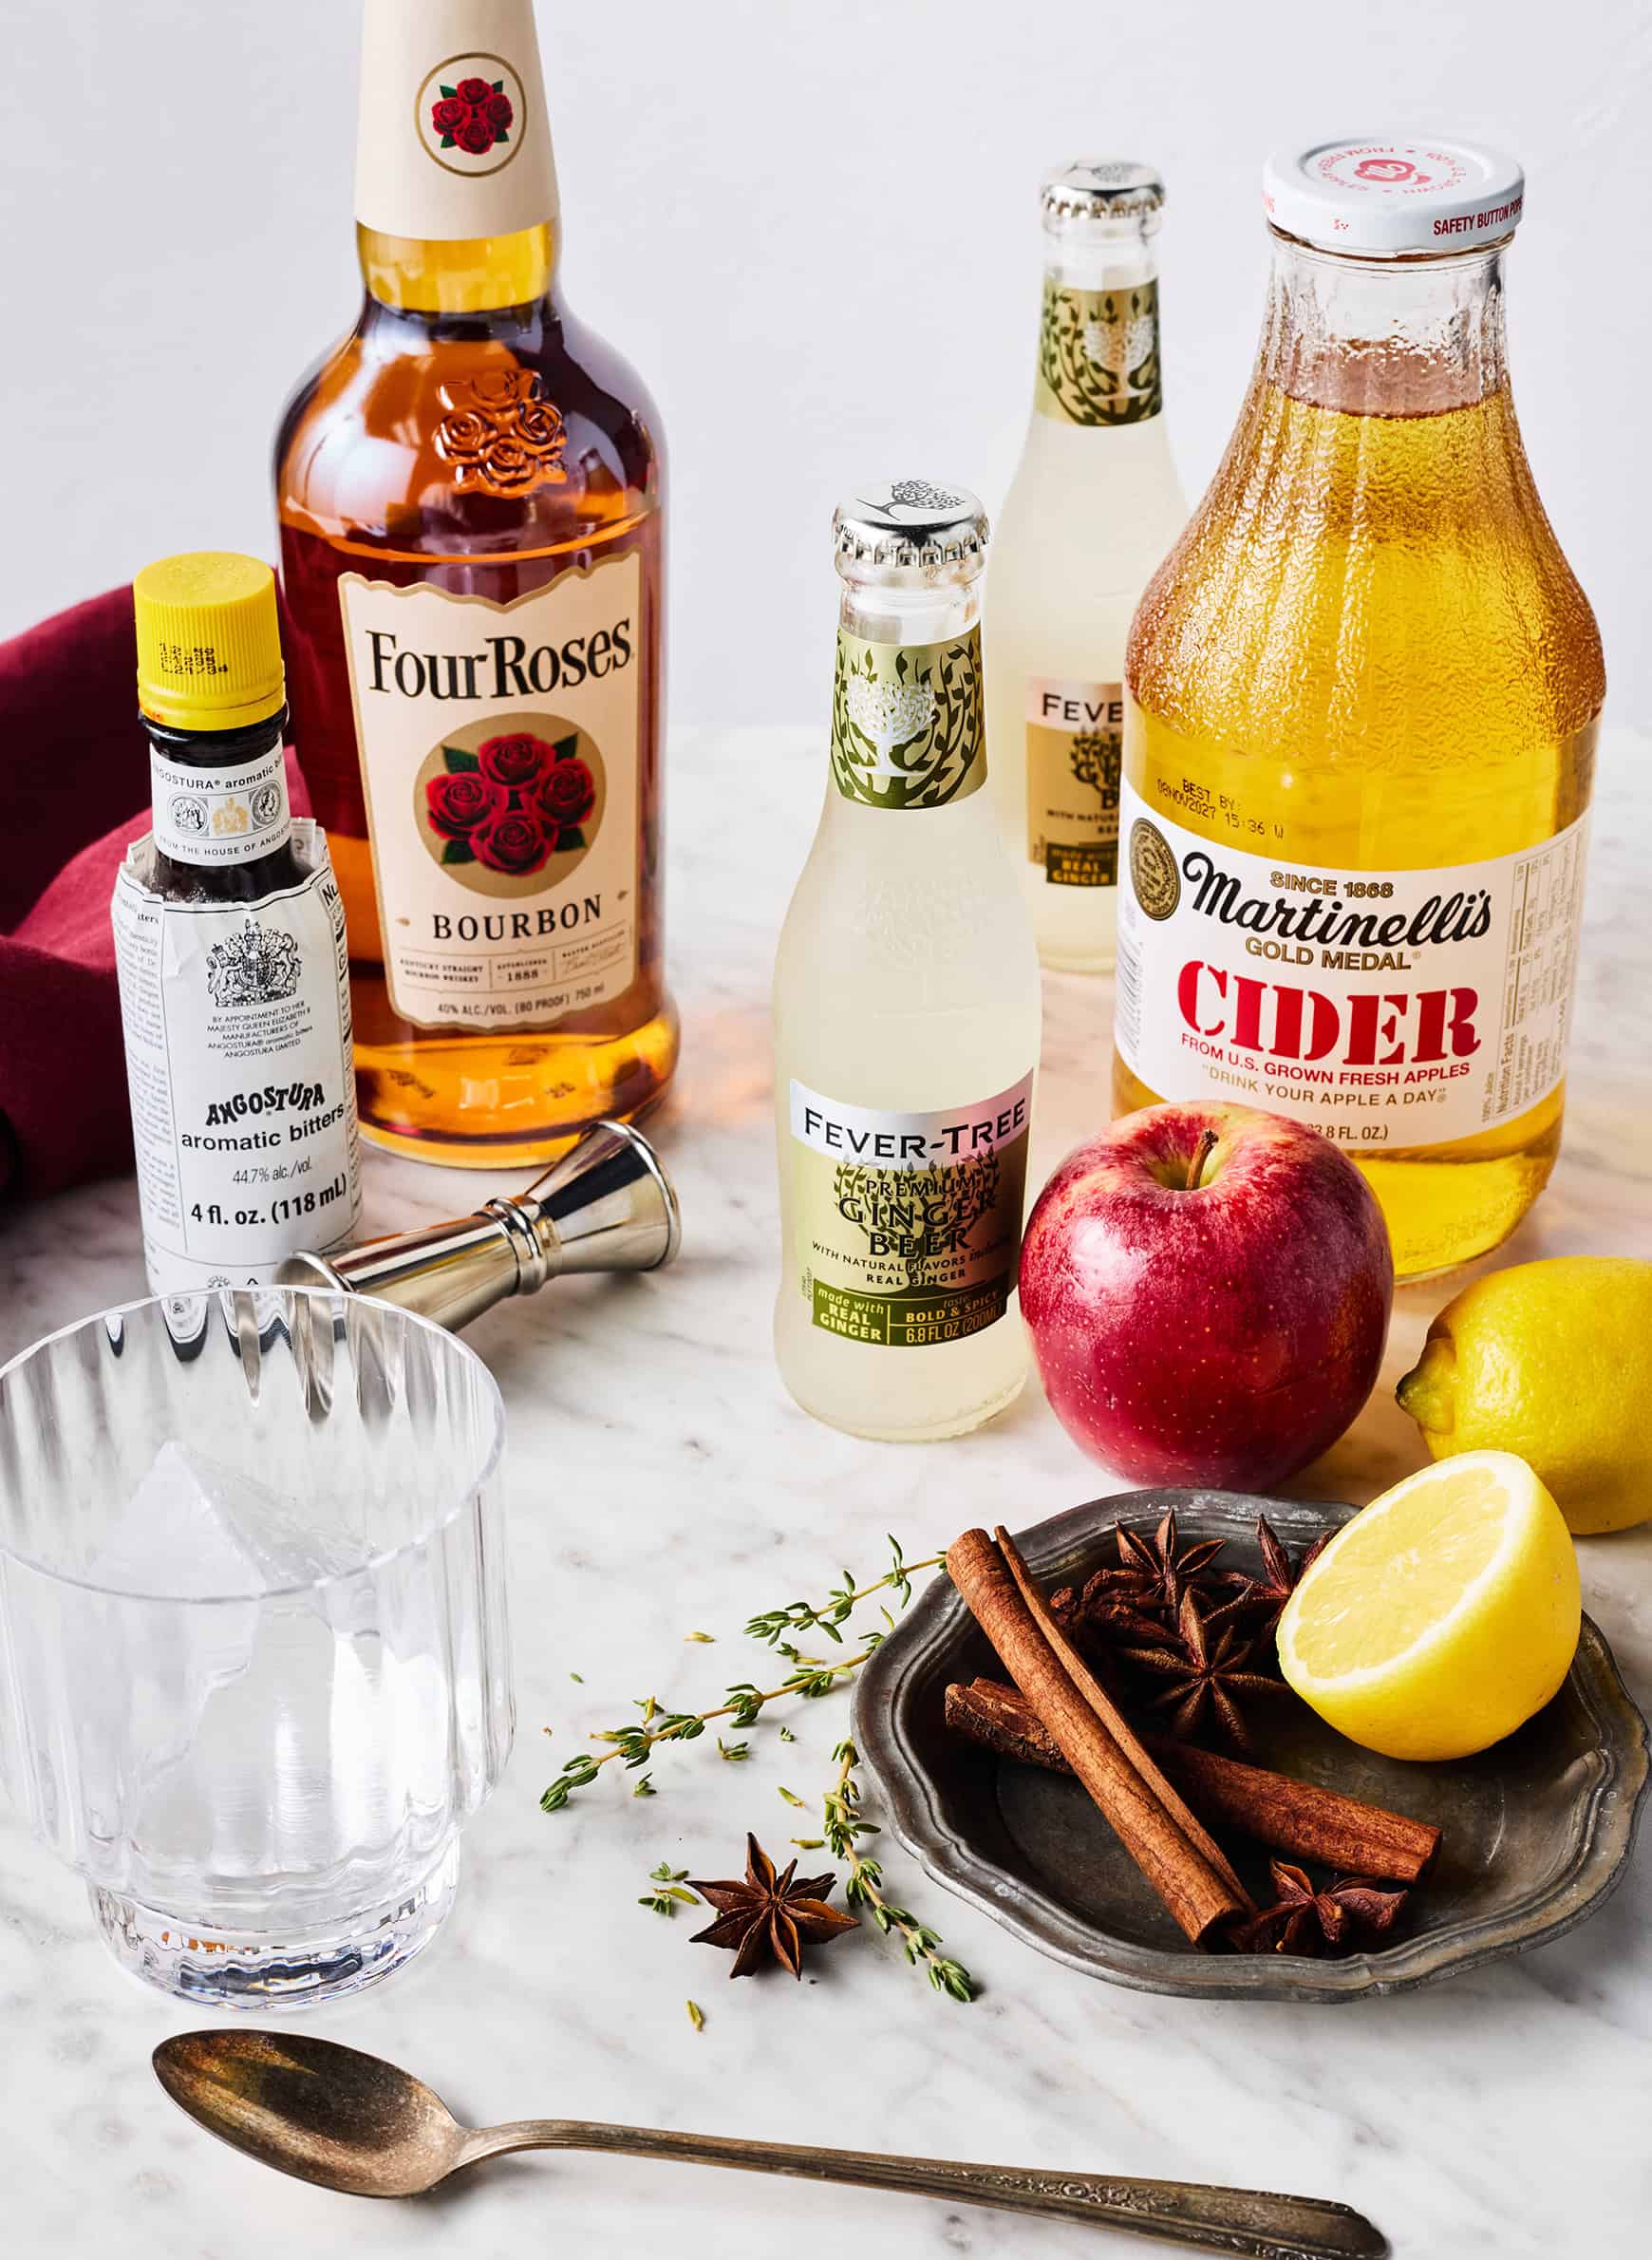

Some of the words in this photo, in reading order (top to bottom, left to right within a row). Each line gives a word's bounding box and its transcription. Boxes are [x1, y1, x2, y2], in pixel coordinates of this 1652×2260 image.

[1433, 215, 1475, 235] SAFETY
[1476, 204, 1510, 228] BUTTON
[365, 629, 489, 700] Four
[484, 617, 632, 699] Roses
[225, 764, 274, 790] aromatic
[1181, 779, 1211, 802] BEST
[1225, 812, 1266, 836] 15:36
[204, 845, 241, 857] HOUSE
[243, 842, 256, 853] OF
[1268, 870, 1339, 897] SINCE
[1342, 880, 1395, 899] 1868
[1181, 850, 1492, 948] Martinelli's
[432, 894, 602, 942] BOURBON
[1244, 935, 1315, 966] GOLD
[507, 969, 539, 983] 1888
[212, 1015, 223, 1024] BY
[224, 1008, 279, 1024] APPOINTMENT
[280, 1006, 291, 1016] TO
[291, 1000, 305, 1010] HER
[438, 1003, 460, 1015] 40%
[575, 987, 591, 1001] 750
[1176, 959, 1482, 1066] CIDER
[207, 1024, 240, 1033] MAJESTY
[242, 1019, 271, 1030] QUEEN
[272, 1009, 306, 1026] ELIZABETH
[221, 1025, 289, 1041] MANUFACTURERS
[289, 1020, 299, 1030] OF
[223, 1045, 274, 1058] ANGOSTURA
[274, 1038, 302, 1052] LIMITED
[1180, 1031, 1225, 1062] FROM
[1228, 1050, 1260, 1073] U.S.
[1264, 1061, 1334, 1084] GROWN
[1339, 1071, 1400, 1086] FRESH
[1403, 1061, 1472, 1085] APPLES
[1500, 1032, 1515, 1065] Facts
[1265, 1083, 1316, 1103] YOUR
[1319, 1092, 1380, 1107] APPLE
[1384, 1092, 1399, 1107] A
[1494, 1064, 1512, 1115] Nutrition
[205, 1082, 327, 1126] ANGOSTURA
[181, 1130, 282, 1152] aromatic
[289, 1102, 345, 1142] bitters
[804, 1097, 1026, 1159] FEVER-TREE
[1338, 1125, 1359, 1140] FL.
[1361, 1123, 1390, 1141] OZ.)
[232, 1167, 271, 1185] 44.7%
[865, 1173, 977, 1198] PREMIUM
[191, 1202, 203, 1223] 4
[206, 1204, 230, 1225] fl.
[234, 1209, 267, 1226] oz.
[271, 1191, 316, 1225] (118
[318, 1172, 347, 1208] mL)
[838, 1190, 998, 1229] GINGER
[811, 1240, 840, 1261] WITH
[842, 1253, 905, 1272] NATURAL
[909, 1254, 967, 1273] FLAVORS
[869, 1227, 974, 1259] BEER
[866, 1273, 904, 1287] REAL
[910, 1269, 967, 1287] GINGER
[817, 1288, 852, 1309] made
[853, 1300, 885, 1315] with
[828, 1303, 872, 1326] REAL
[905, 1309, 947, 1324] BOLD
[949, 1303, 961, 1318] &
[818, 1311, 882, 1341] GINGER
[905, 1326, 927, 1345] 6.8
[928, 1324, 943, 1342] FL
[944, 1321, 961, 1338] OZ
